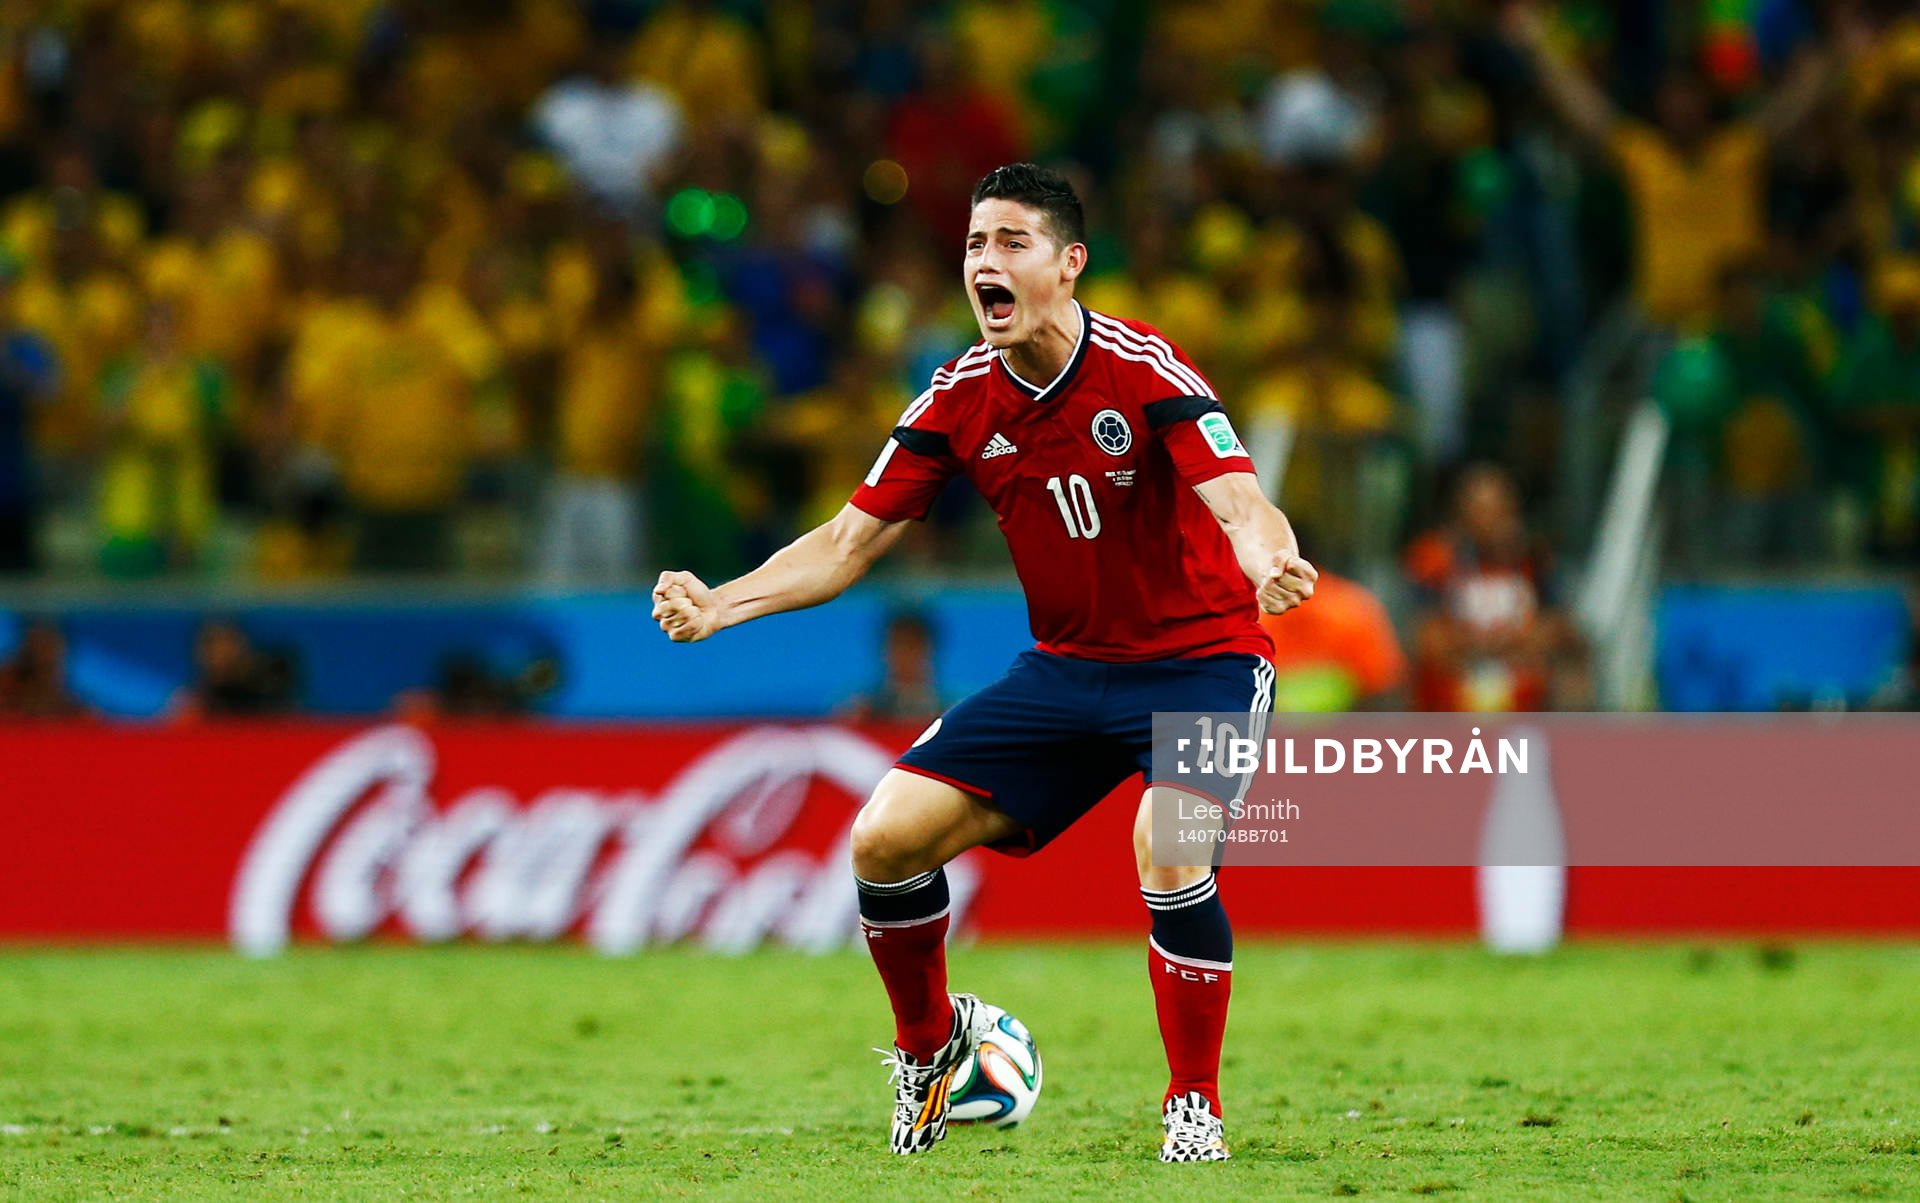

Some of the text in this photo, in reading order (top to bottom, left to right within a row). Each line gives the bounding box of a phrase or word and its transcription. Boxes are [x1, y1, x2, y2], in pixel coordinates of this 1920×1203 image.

[981, 445, 1018, 459] adidas
[1046, 474, 1101, 539] 10
[1195, 716, 1241, 778] 10
[1164, 961, 1219, 984] FCF
